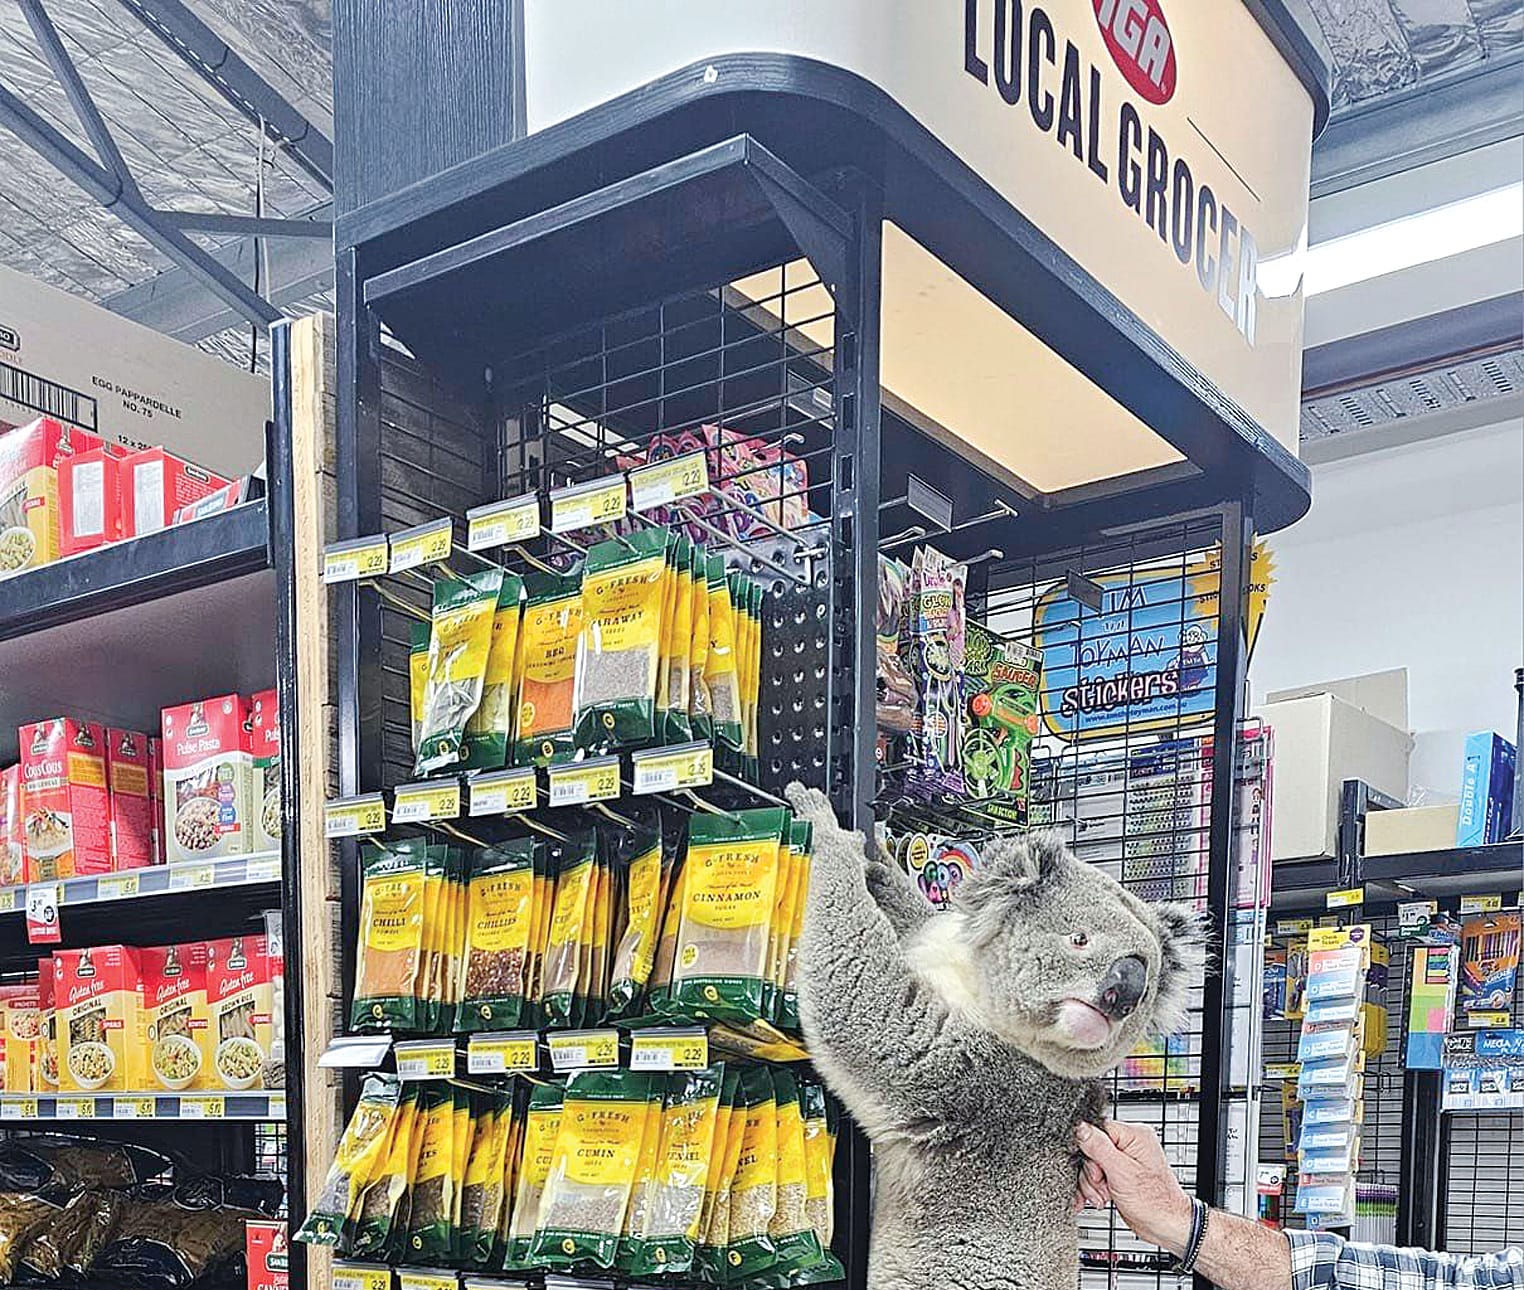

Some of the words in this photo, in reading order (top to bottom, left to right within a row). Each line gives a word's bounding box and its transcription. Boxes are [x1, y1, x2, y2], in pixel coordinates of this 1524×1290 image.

[1100, 0, 1170, 82] IGA
[965, 0, 1107, 184] LOCAL
[1117, 102, 1257, 347] GROCER
[92, 376, 112, 391] EGG
[115, 385, 182, 419] PAPPARDELLE
[1061, 666, 1179, 718] Stickers
[1462, 775, 1475, 825] Double
[692, 890, 761, 904] CINNAMON
[576, 1148, 615, 1158] CUMIN
